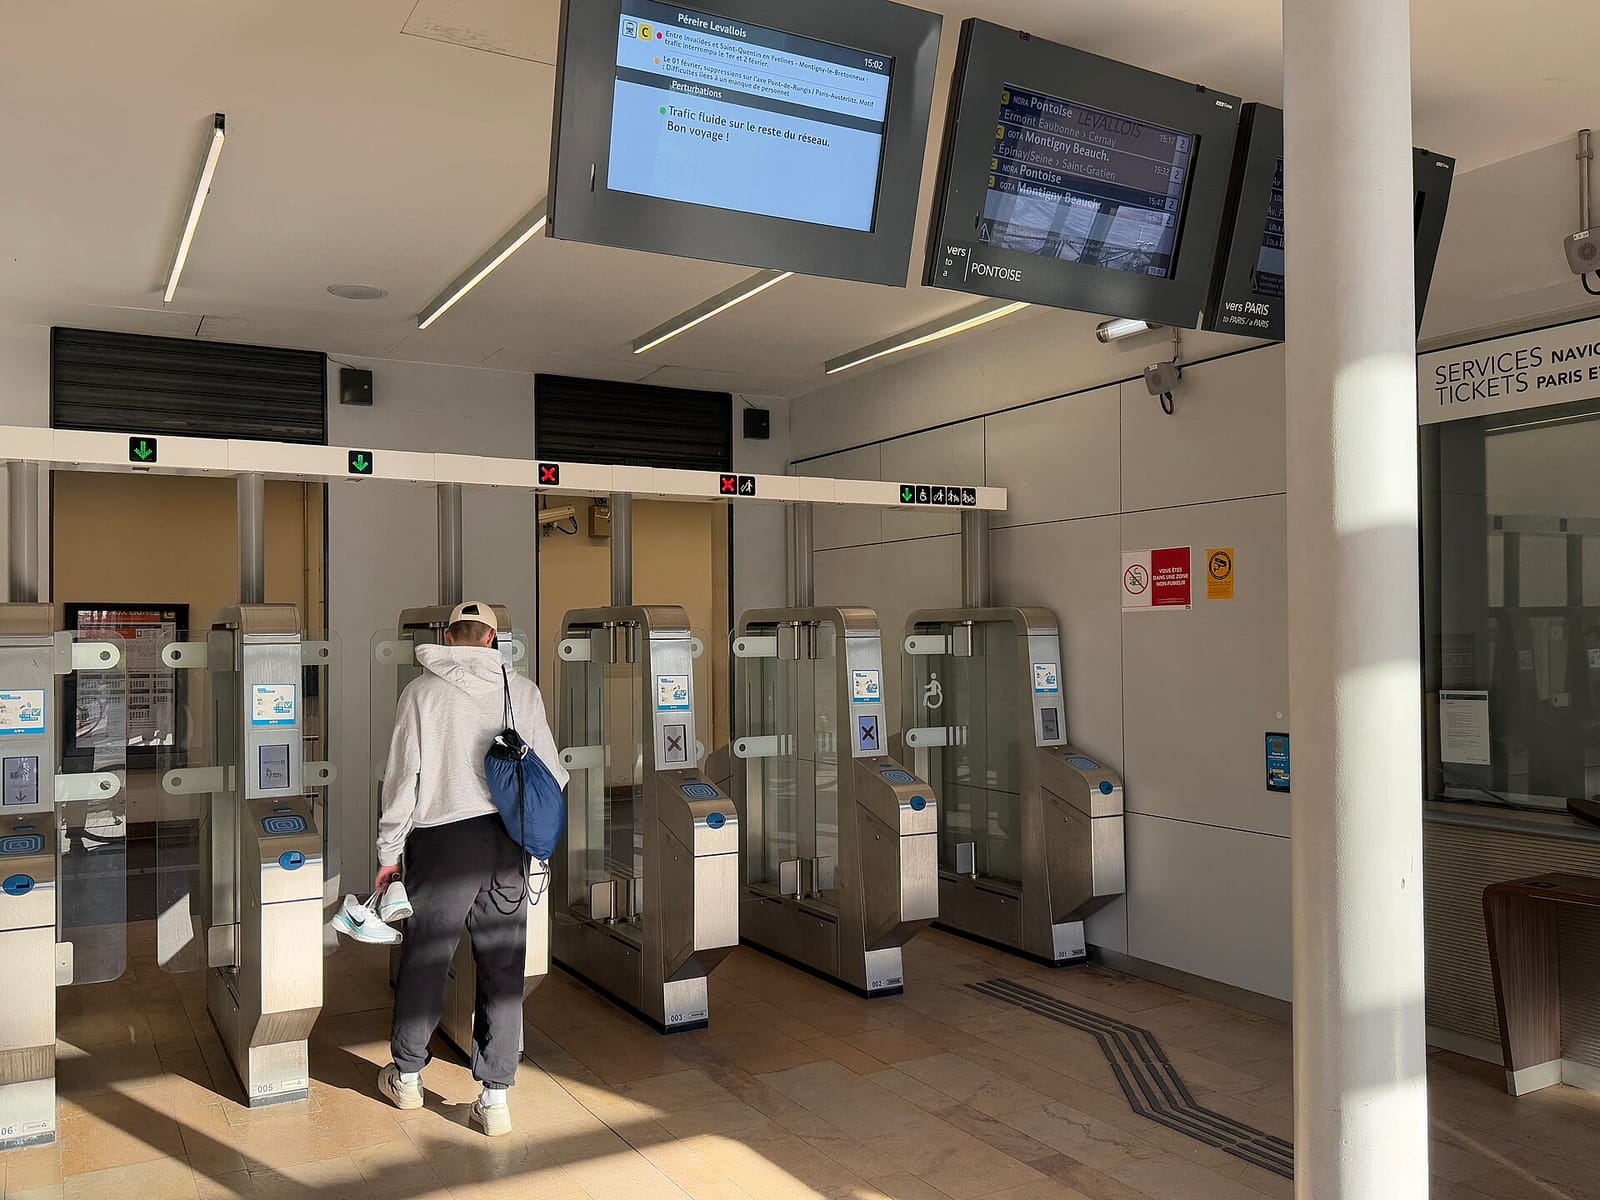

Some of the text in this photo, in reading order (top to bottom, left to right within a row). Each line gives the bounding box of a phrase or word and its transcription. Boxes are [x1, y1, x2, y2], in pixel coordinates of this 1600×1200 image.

[641, 27, 649, 37] C
[678, 13, 747, 38] Péreire Levallois
[664, 39, 681, 49] trafic
[683, 41, 717, 56] interrompu
[726, 51, 735, 60] 1er
[736, 53, 743, 61] et
[665, 31, 682, 41] Entre
[684, 34, 711, 47] Invalides
[712, 41, 719, 49] et
[720, 43, 761, 59] Saint-Quentin
[771, 53, 794, 66] Yvelines
[864, 58, 883, 70] 15:02
[663, 55, 671, 63] Le
[672, 57, 680, 65] 01
[704, 64, 741, 80] suppressions
[768, 78, 811, 94] Pont-de-Rungis
[859, 98, 874, 108] Motif
[671, 80, 722, 99] Perturbations
[729, 78, 751, 89] manque
[753, 82, 760, 90] de
[761, 84, 790, 97] personnel
[667, 120, 686, 134] Bon
[689, 127, 723, 143] voyage
[668, 105, 830, 147] Trafic fluide sur le reste du réseau.
[1005, 109, 1116, 148] Ermont Eaubonne Cernay
[1013, 95, 1185, 149] NORA Pontoise 15:17 2
[1078, 111, 1143, 138] LEVALLOIS
[999, 143, 1053, 165] Épinay/Seine
[1062, 159, 1116, 180] Saint-Gratien
[1007, 130, 1180, 180] GOTA Montigny Beauch. 15:32 2
[1000, 182, 1015, 192] GOTA
[1017, 181, 1062, 201] Montigny
[1002, 164, 1018, 174] NORA
[1020, 164, 1062, 184] Pontoise
[1149, 197, 1164, 206] 15:47
[1168, 200, 1174, 209] 2
[945, 258, 953, 266] to
[947, 246, 1022, 282] vers PONTOISE
[1225, 301, 1270, 316] vers PARIS
[1222, 315, 1229, 323] to
[1230, 315, 1246, 325] PARIS
[1253, 319, 1270, 329] PARIS
[1435, 347, 1543, 385] SERVICES
[1435, 372, 1529, 406] TICKETS
[1536, 369, 1583, 389] PARIS
[671, 1014, 683, 1022] 003
[257, 1083, 273, 1093] 005
